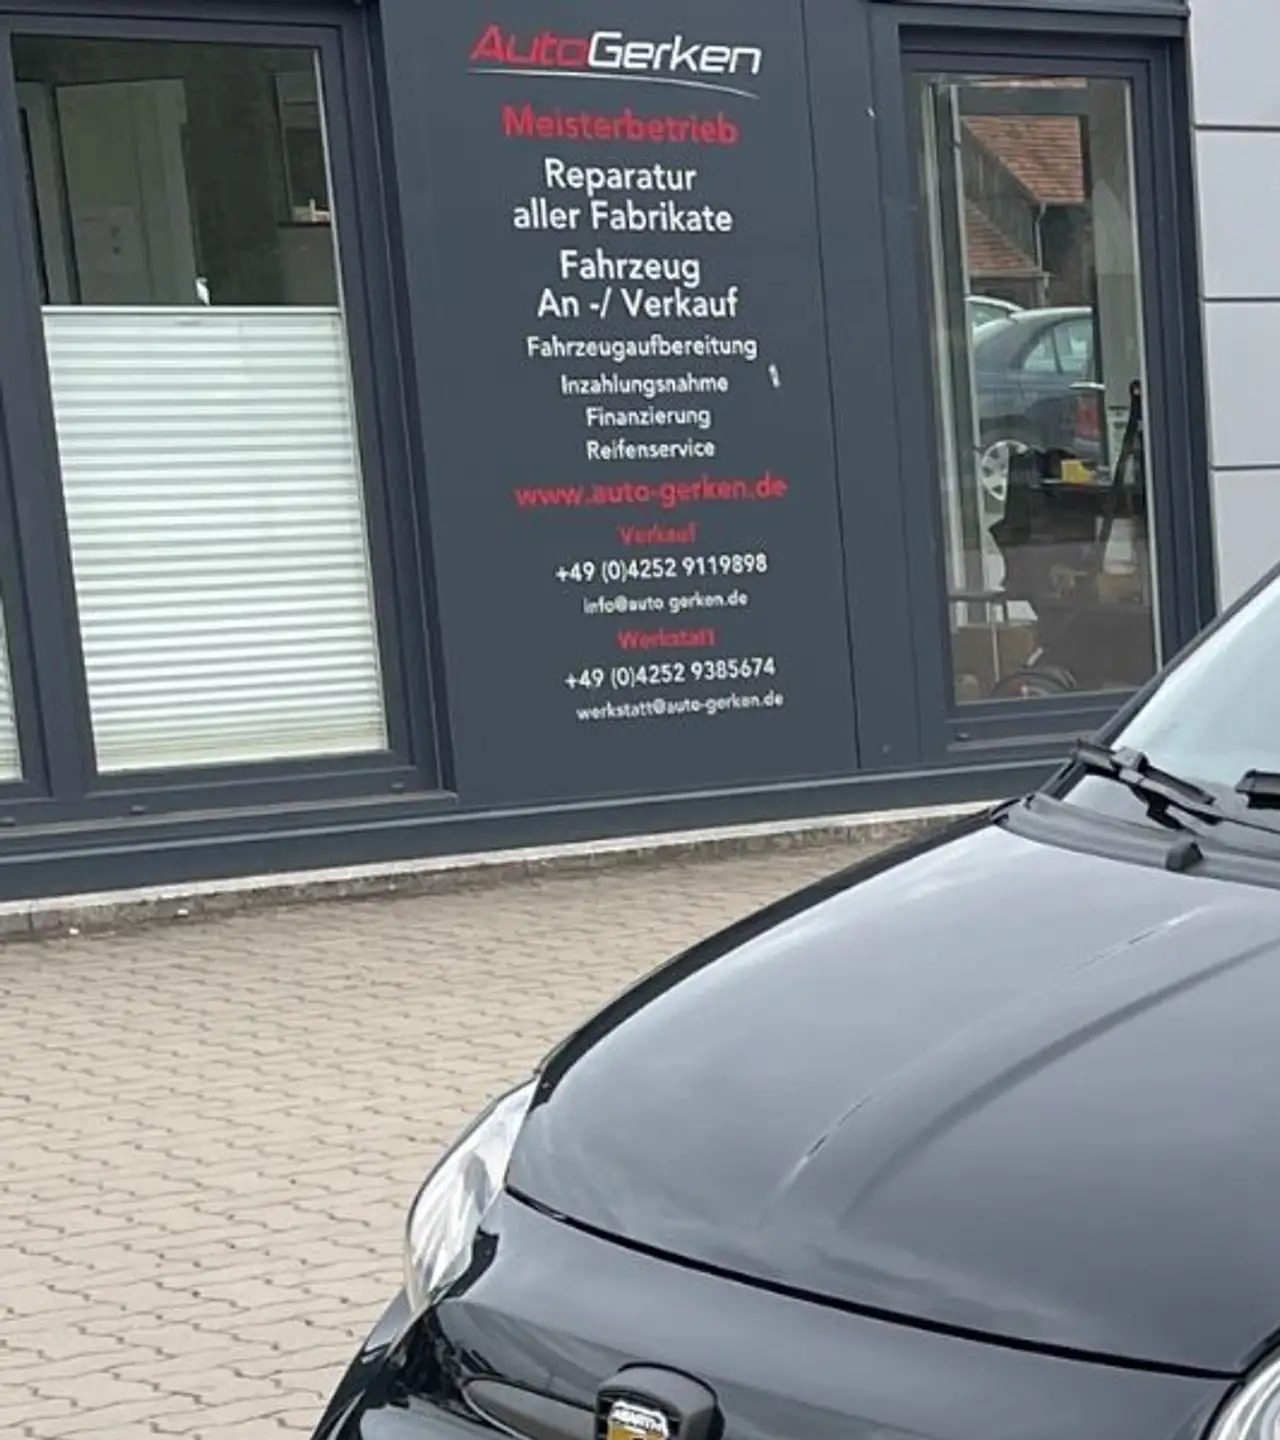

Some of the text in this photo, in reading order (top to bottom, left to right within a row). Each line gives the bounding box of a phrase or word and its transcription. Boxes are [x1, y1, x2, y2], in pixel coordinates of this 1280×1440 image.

[470, 24, 762, 75] AutoGerken
[503, 106, 740, 144] Meisterbetrieb
[544, 158, 697, 196] Reparatur
[513, 197, 732, 232] aller Fabrikate
[560, 248, 701, 287] Fahrzeug
[537, 288, 580, 318] An
[621, 286, 740, 318] Verkauf
[526, 334, 757, 363] Fahrzeugaufbereitung
[561, 372, 729, 399] Inzahlungsnahme
[585, 406, 712, 430] Finanzierung
[586, 438, 716, 460] Reifenservice
[515, 473, 788, 507] www.auto-gerken.de
[617, 522, 697, 544] Verkauf
[555, 552, 768, 584] +49 (0)4252 9119898
[583, 589, 749, 614] info@autogerken.de
[616, 628, 716, 650] Werkstatt
[565, 656, 776, 690] +49 (0)4252 9385674
[576, 690, 784, 722] werkstatt@auto-gerken.de
